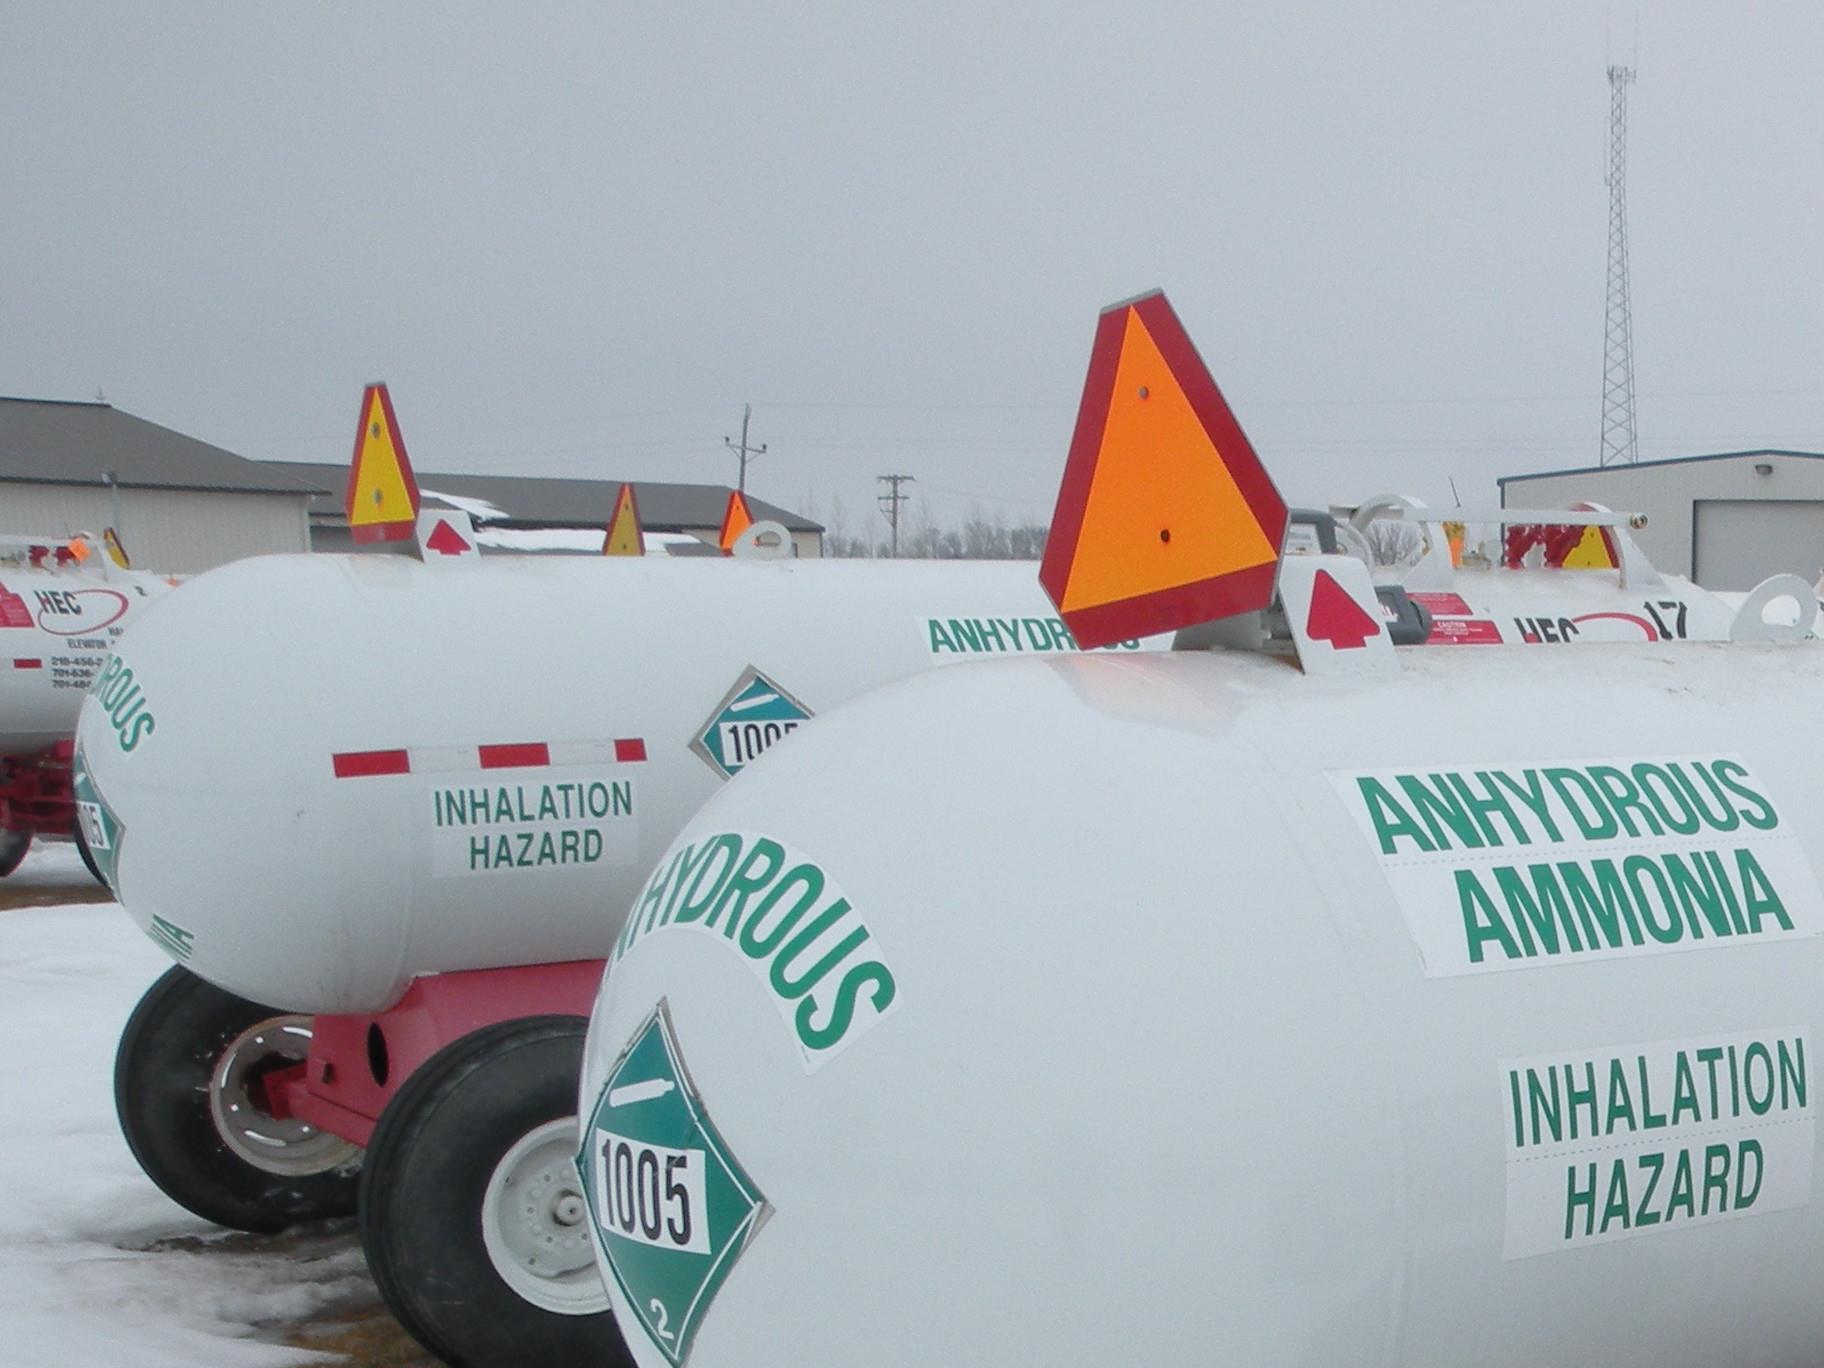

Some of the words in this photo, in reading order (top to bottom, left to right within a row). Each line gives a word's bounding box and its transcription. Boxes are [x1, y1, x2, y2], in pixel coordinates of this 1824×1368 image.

[34, 590, 82, 615] HEC
[1644, 602, 1688, 639] 17
[928, 618, 1141, 654] ANHYDR
[435, 781, 632, 826] INHALATION
[1356, 760, 1779, 855] ANHYDROUS
[470, 829, 604, 870] HAZARD
[1454, 848, 1795, 963] AMMONIA
[1509, 1037, 1808, 1147] INHALATION
[600, 1141, 691, 1246] 1005
[1564, 1138, 1765, 1239] HAZARD
[650, 1298, 675, 1340] 2
